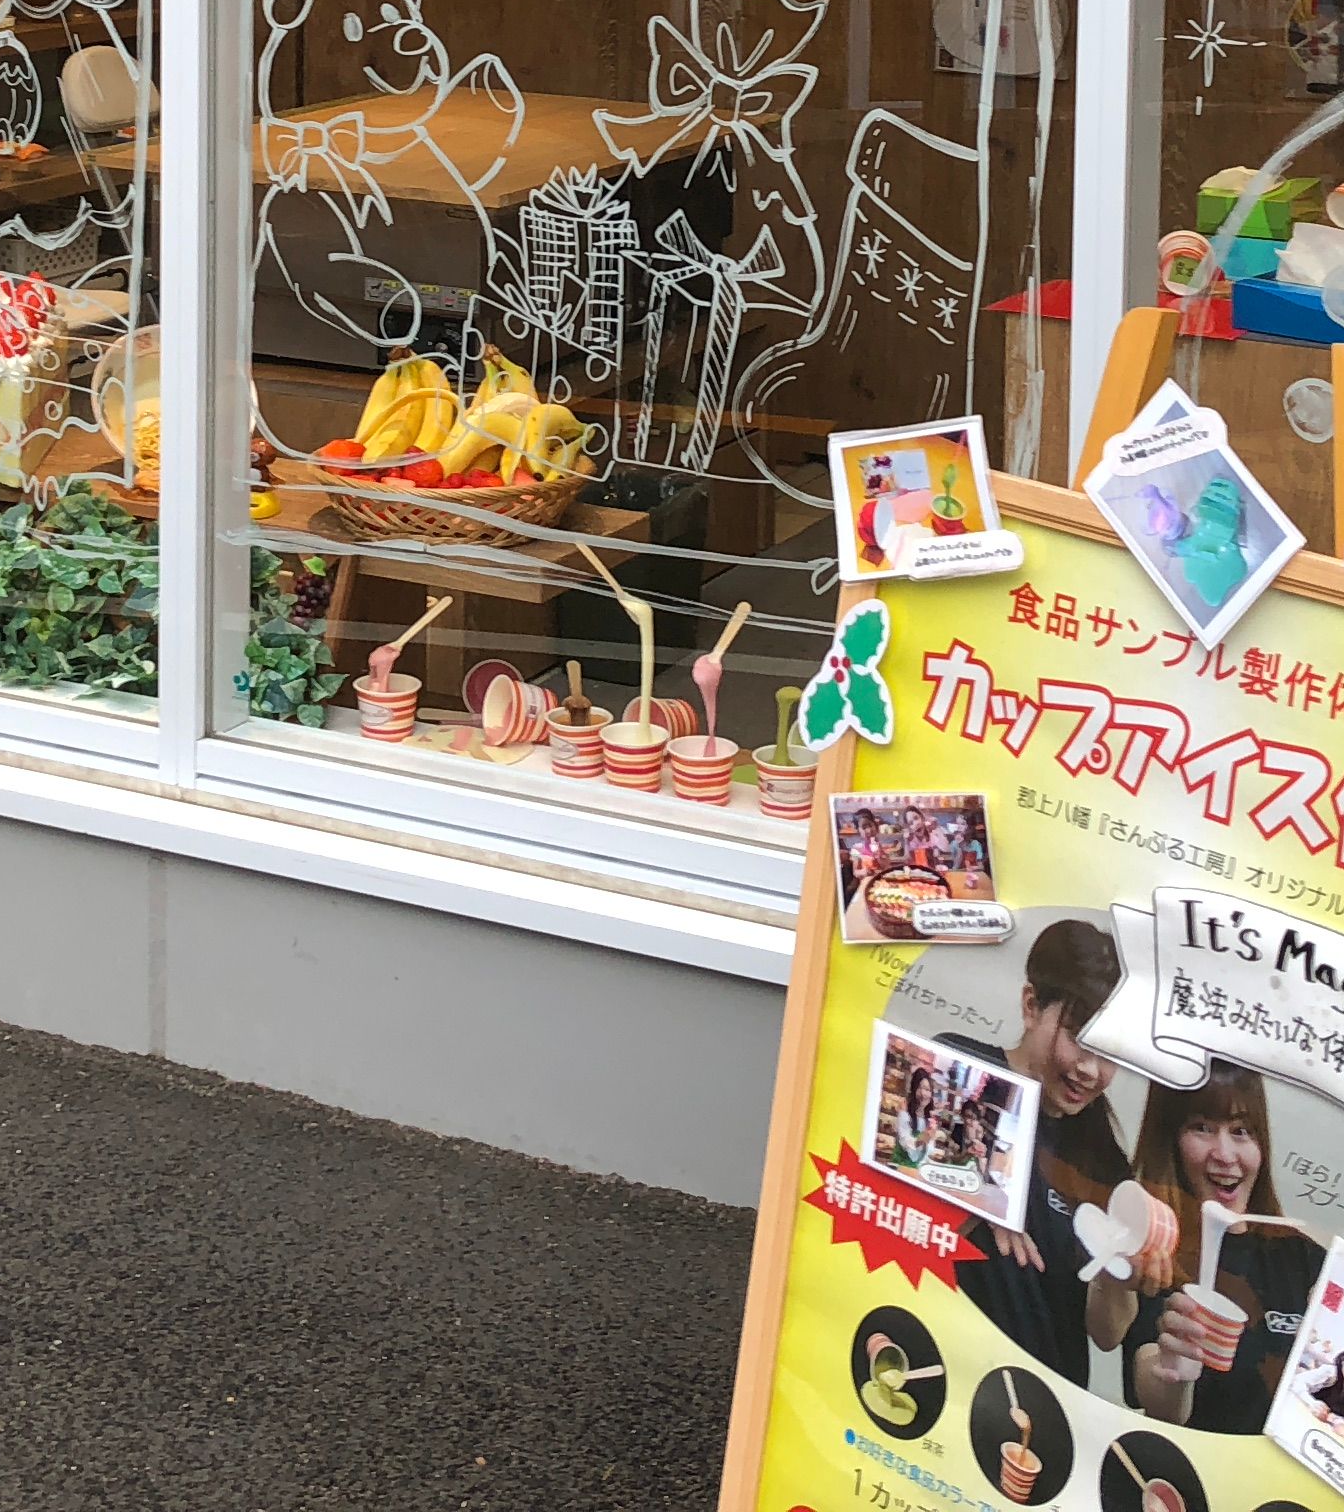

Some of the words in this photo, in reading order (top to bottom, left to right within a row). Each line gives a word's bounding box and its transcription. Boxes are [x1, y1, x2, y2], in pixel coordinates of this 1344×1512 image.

[1178, 898, 1263, 963] It's
[823, 1169, 959, 1258] 特許出願中
